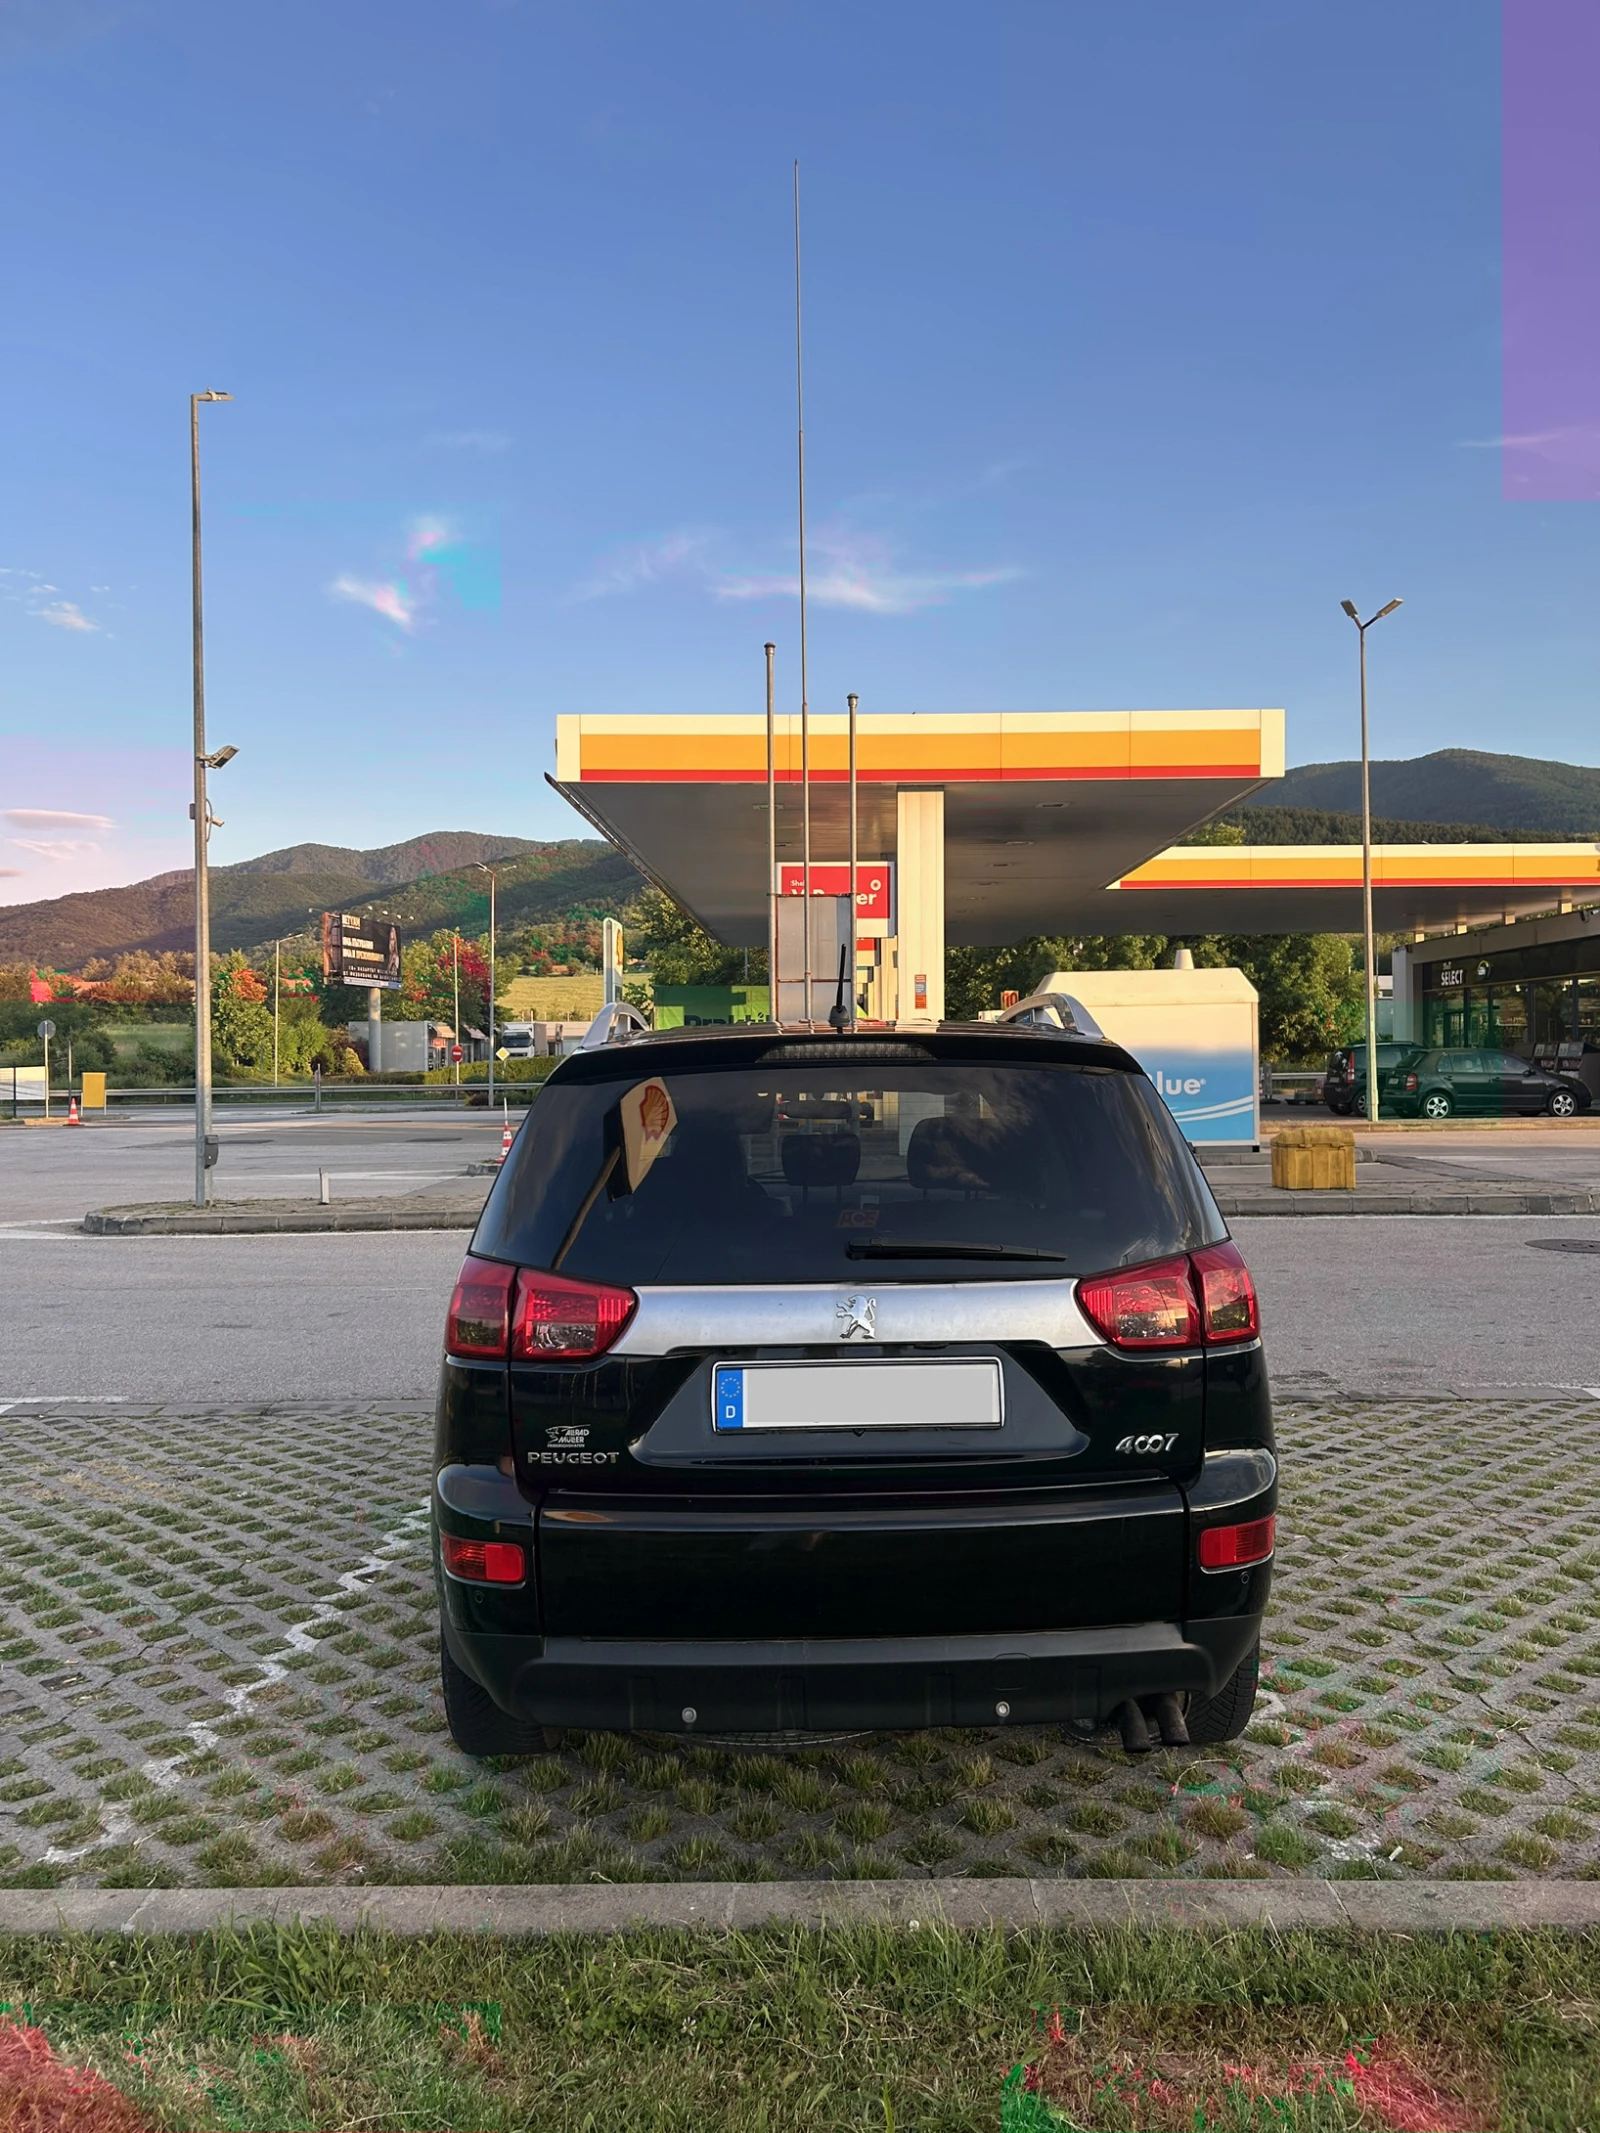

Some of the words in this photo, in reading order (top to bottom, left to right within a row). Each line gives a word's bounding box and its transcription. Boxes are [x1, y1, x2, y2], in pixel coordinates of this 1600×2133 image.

[1441, 969, 1463, 986] SELECT
[839, 1210, 879, 1227] ACE
[725, 1405, 736, 1419] D
[565, 1428, 591, 1437] ALLRAD
[1115, 1432, 1179, 1454] 4007
[527, 1451, 620, 1465] PEUGEOT
